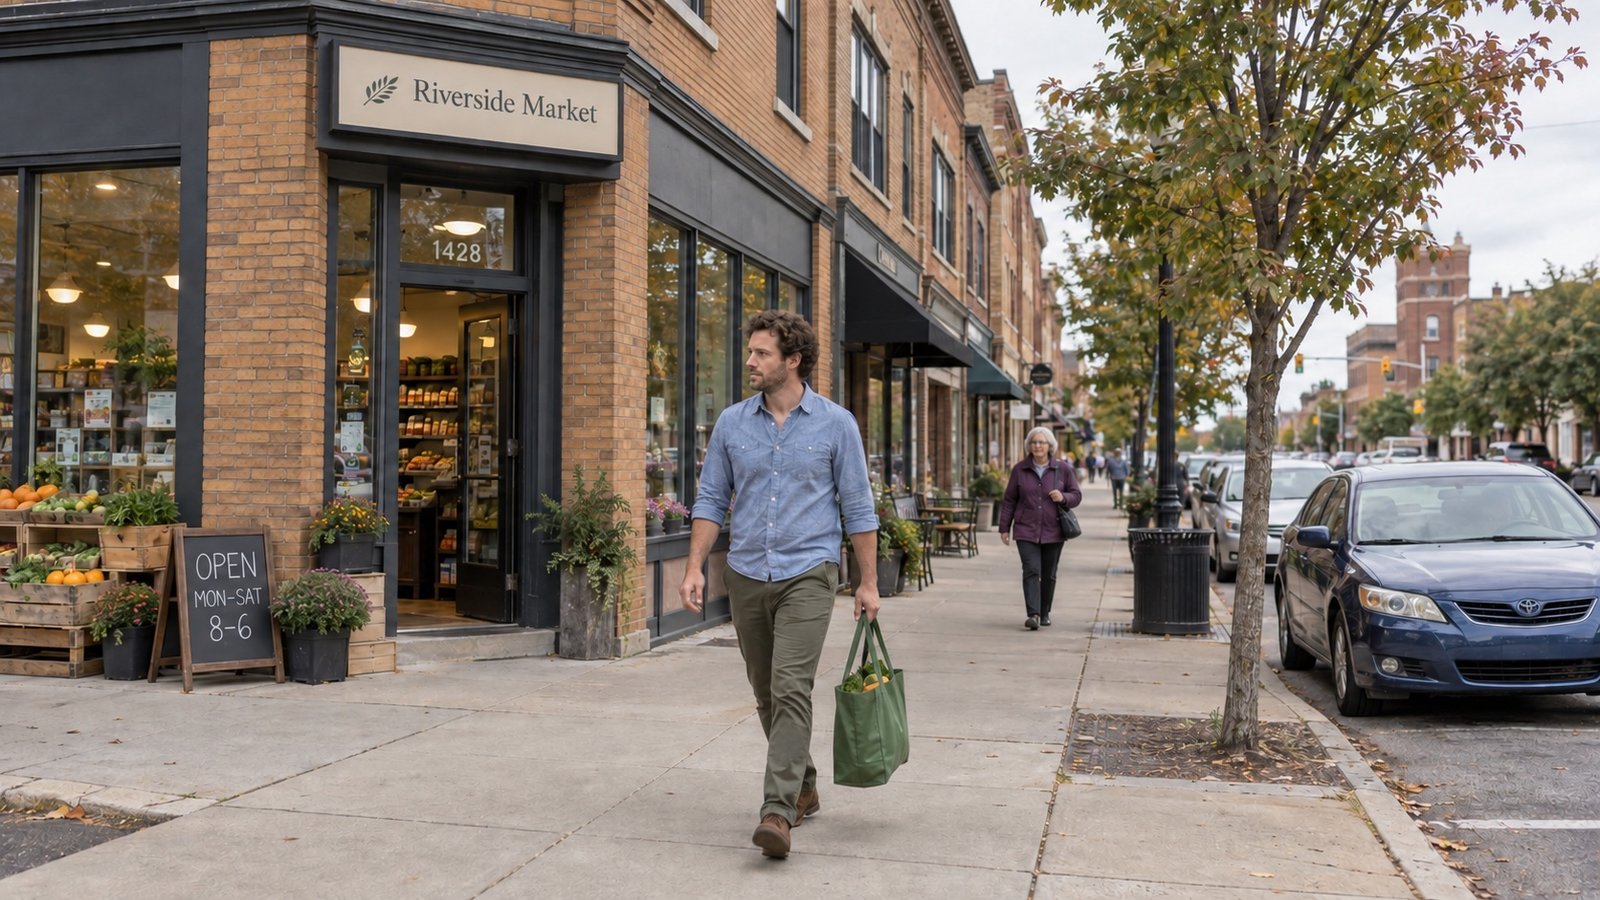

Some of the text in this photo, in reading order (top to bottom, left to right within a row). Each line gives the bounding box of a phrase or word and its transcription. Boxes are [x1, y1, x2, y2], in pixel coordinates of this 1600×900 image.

[414, 79, 597, 123] Riverside Market
[433, 240, 480, 263] 1428
[196, 552, 256, 580] OPEN
[194, 587, 262, 608] MON-SAT
[210, 613, 252, 641] 8-6
